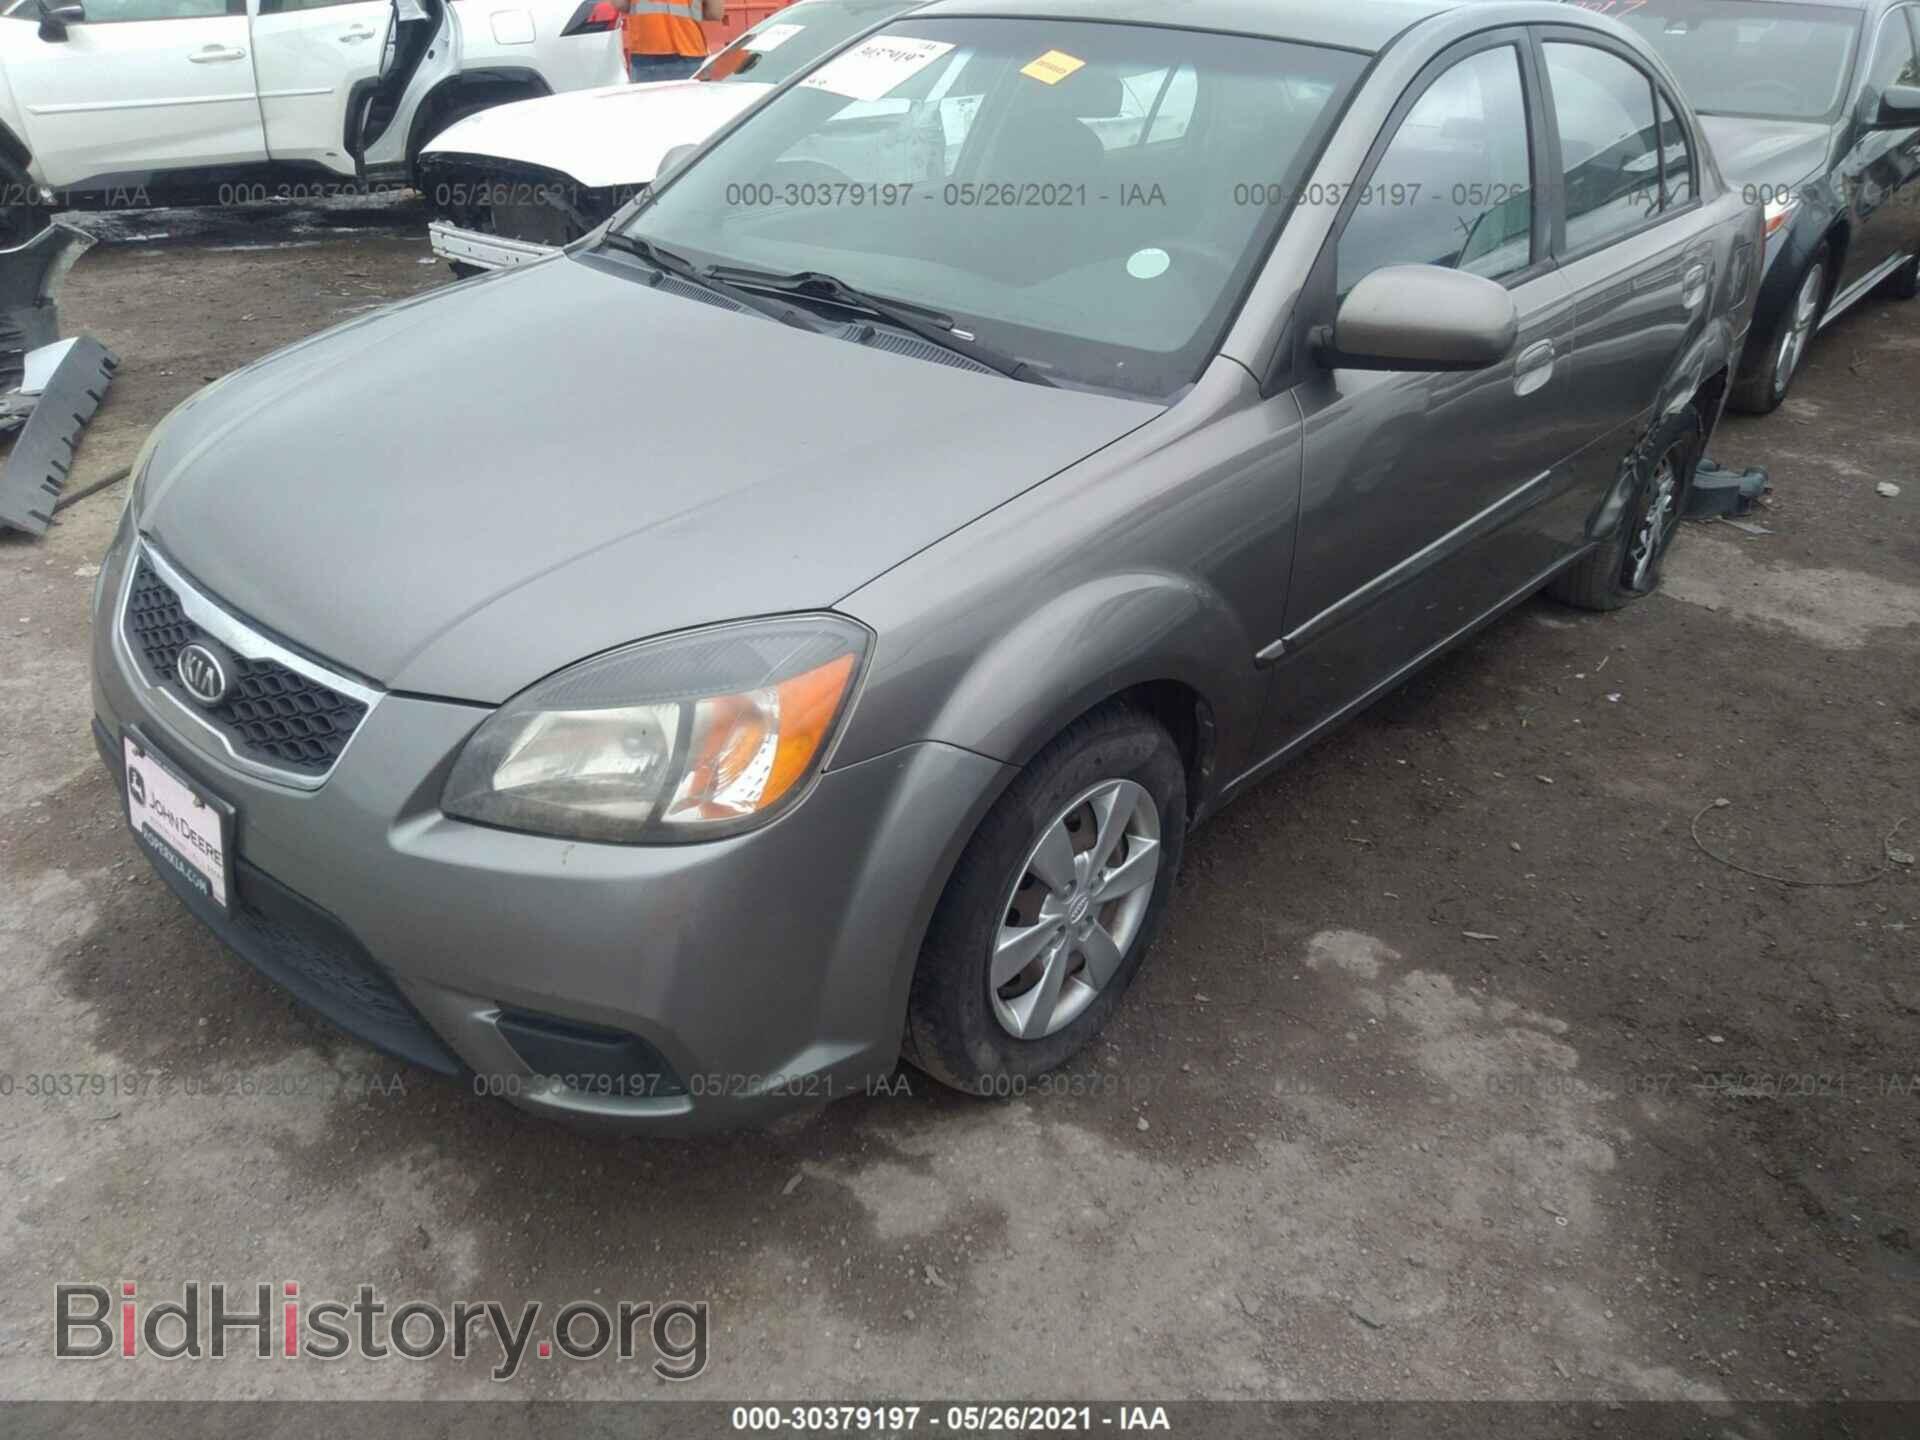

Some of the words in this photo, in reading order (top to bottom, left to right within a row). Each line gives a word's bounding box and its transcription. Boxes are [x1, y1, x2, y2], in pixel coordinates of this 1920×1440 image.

[183, 651, 215, 697] KIA
[149, 792, 180, 833] JOHN
[180, 817, 223, 868] DEERE
